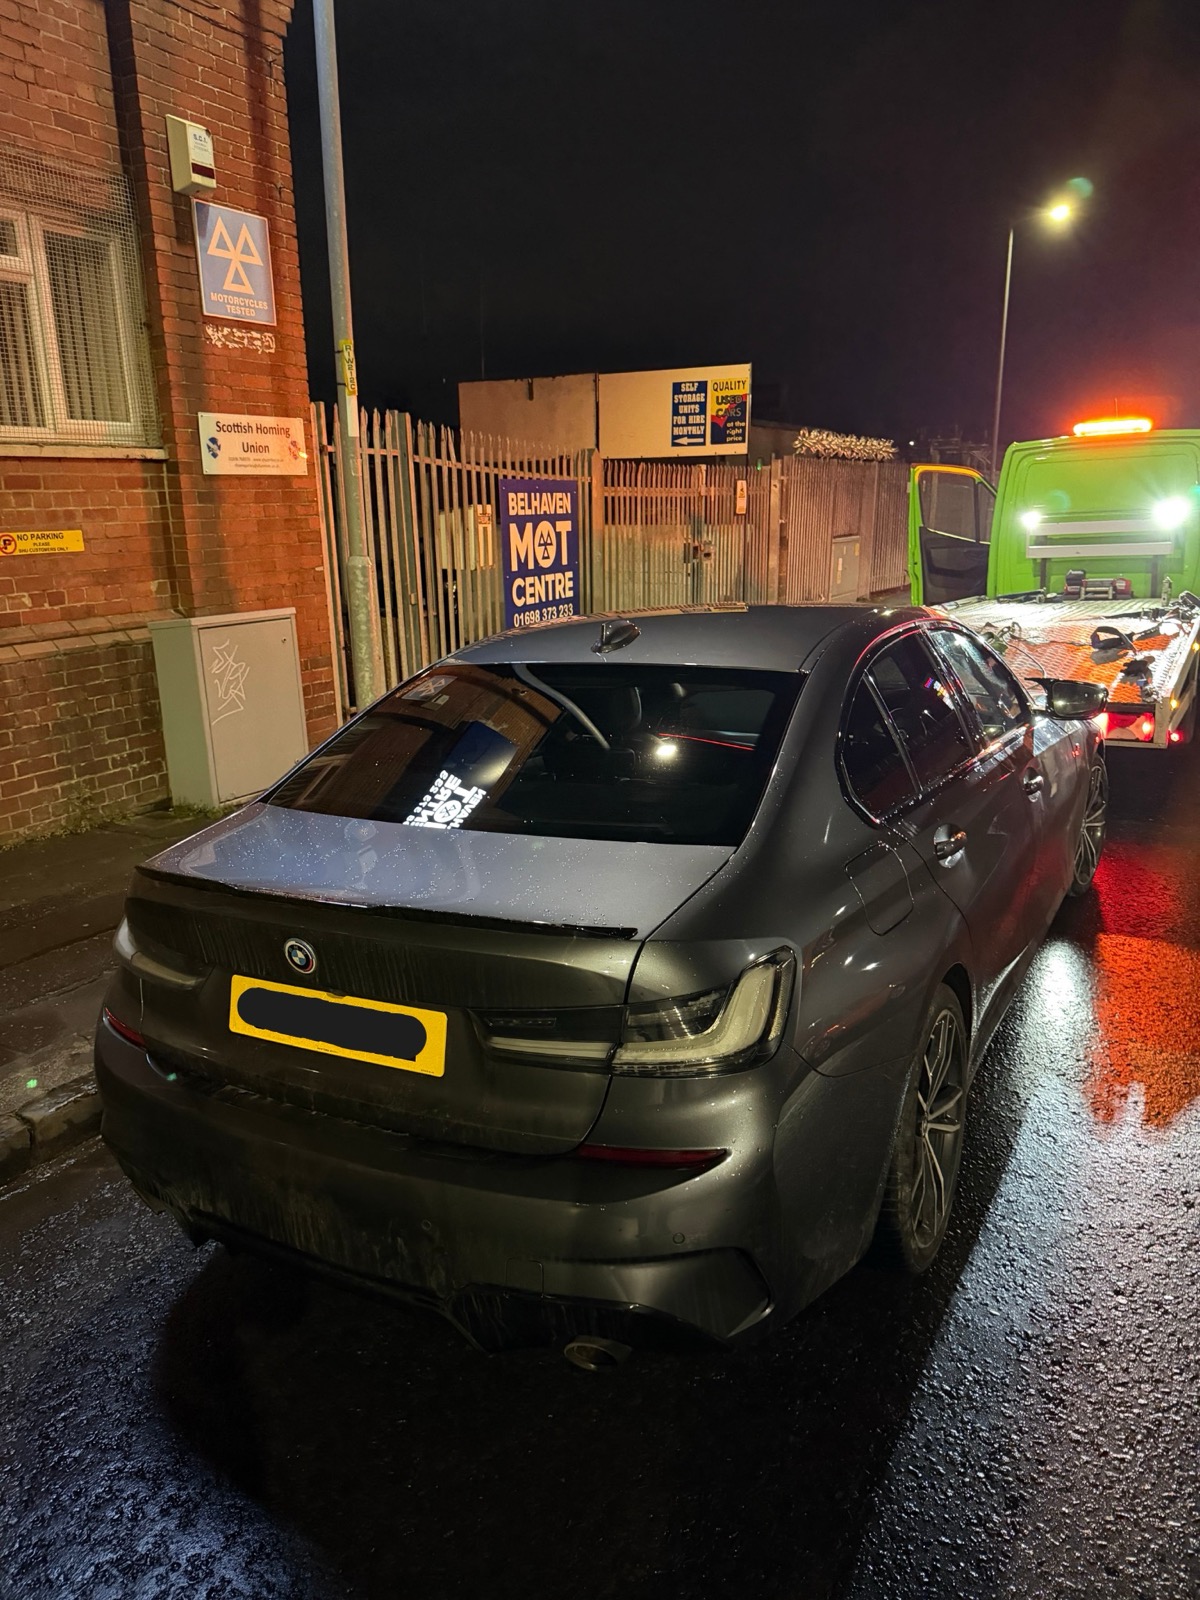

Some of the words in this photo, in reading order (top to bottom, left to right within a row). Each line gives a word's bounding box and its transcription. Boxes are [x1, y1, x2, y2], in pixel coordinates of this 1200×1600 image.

[210, 292, 268, 310] MOTORCYCLES
[226, 305, 256, 316] TESTED
[680, 382, 698, 392] SELF
[712, 380, 746, 392] QUALITY
[674, 393, 706, 404] STORAGE
[716, 394, 742, 406] USED
[678, 404, 700, 414] UNITS
[715, 407, 742, 418] CARS
[673, 416, 686, 425] FOR
[688, 415, 706, 424] HIRE
[215, 420, 254, 434] Scottish
[255, 423, 291, 439] Homing
[672, 426, 704, 436] MONTHLY
[242, 442, 270, 454] Union
[508, 492, 572, 516] BELHAVEN
[16, 534, 28, 542] NO
[30, 532, 64, 540] PARKING
[509, 520, 572, 572] MOT
[512, 571, 574, 608] CENTRE
[514, 609, 540, 628] 01698
[542, 606, 558, 621] 373
[558, 603, 574, 618] 233
